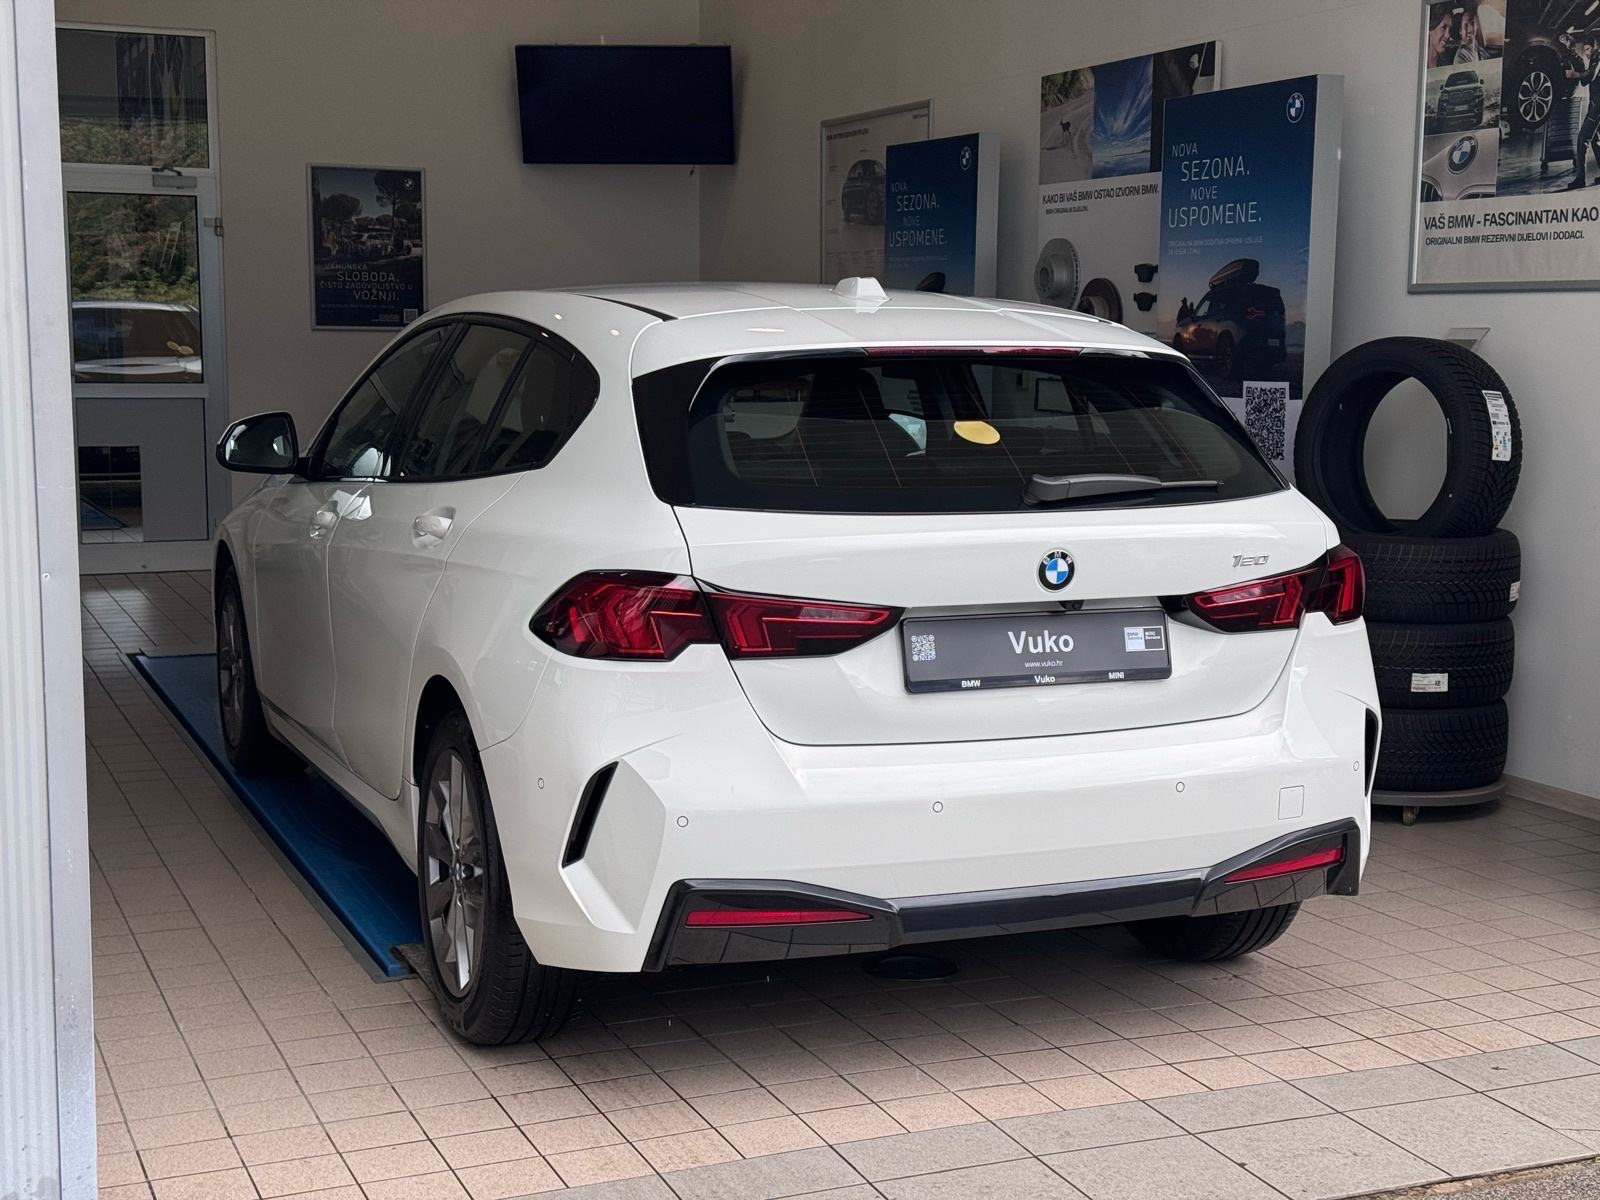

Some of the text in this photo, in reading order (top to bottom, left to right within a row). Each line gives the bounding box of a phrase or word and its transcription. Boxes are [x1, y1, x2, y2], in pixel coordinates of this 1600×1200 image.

[1172, 142, 1198, 157] NOVA
[1181, 155, 1250, 181] SEZONA.
[890, 182, 907, 192] NOVA
[1042, 194, 1058, 204] KAKO
[1059, 193, 1065, 203] BI
[1065, 189, 1078, 202] VAŠ
[1078, 191, 1093, 201] BMW
[1093, 188, 1115, 199] OSTAO
[1115, 185, 1140, 198] IZVORNI
[1190, 185, 1218, 201] NOVE
[896, 192, 940, 212] SEZONA.
[903, 215, 921, 226] NOVE
[1168, 201, 1262, 228] USPOMENE.
[1424, 212, 1445, 230] VAŠ
[1447, 214, 1475, 229] BMW
[1483, 208, 1569, 227] FASCINANTAN
[1571, 206, 1599, 222] KAO
[888, 228, 948, 247] USPOMENE.
[1425, 234, 1463, 246] ORIGINALNI
[1463, 234, 1481, 245] BMW
[1481, 232, 1517, 244] REZERVNI
[1517, 231, 1548, 242] DIJELOVI
[1553, 230, 1585, 241] DODACI.
[336, 271, 399, 282] SLOBODA.
[320, 281, 343, 289] ČISTO
[345, 282, 405, 290] ZADOVOLJSTVO
[353, 289, 399, 301] VOŽNJI.
[1232, 552, 1270, 568] 120
[1007, 630, 1075, 654] Vuko
[1024, 659, 1063, 668] www.vuko.hr
[1034, 675, 1056, 684] Vuko
[1108, 671, 1125, 680] MINI
[961, 679, 981, 688] BMW
